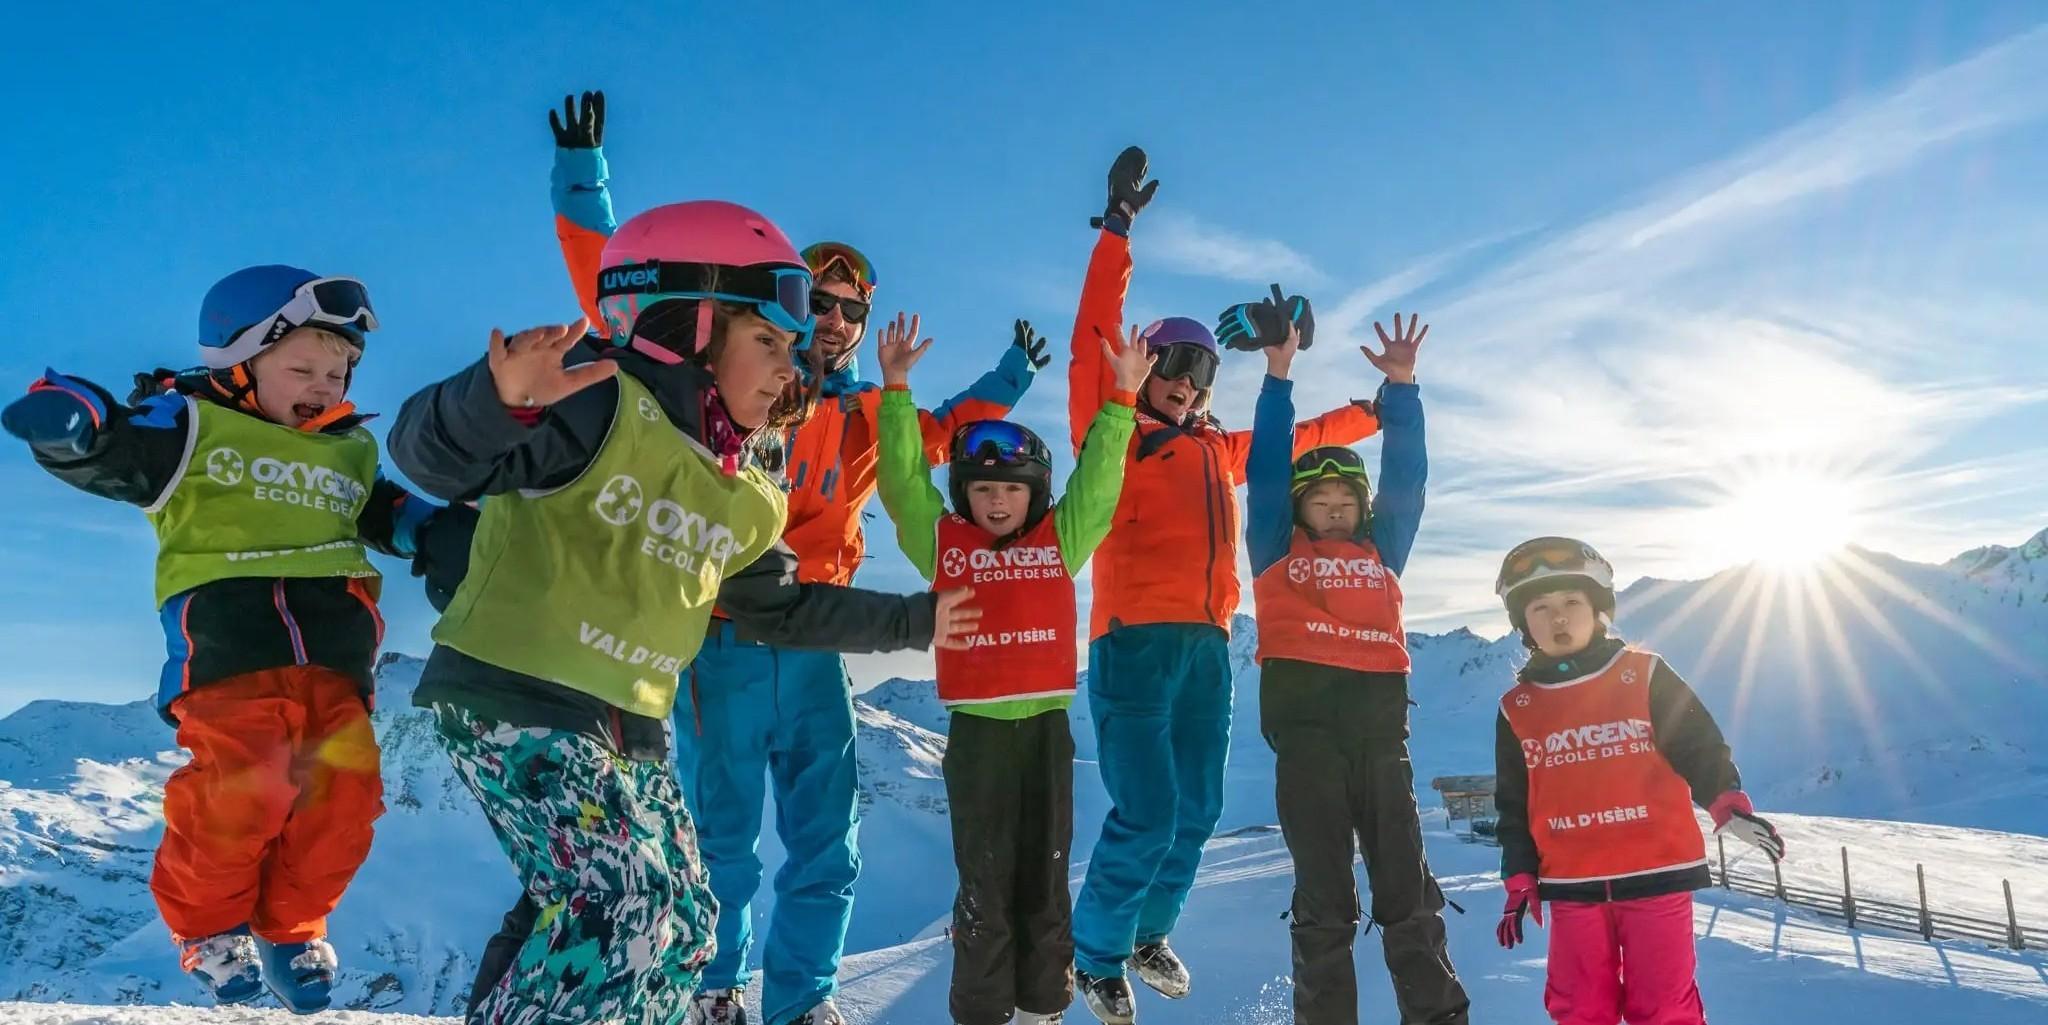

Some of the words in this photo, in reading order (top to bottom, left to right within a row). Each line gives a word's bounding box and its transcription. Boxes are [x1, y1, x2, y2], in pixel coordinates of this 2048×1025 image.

[603, 268, 659, 290] uvex
[254, 486, 326, 510] ECOLE
[329, 500, 349, 516] DE
[647, 499, 745, 561] OXYG
[641, 535, 698, 575] ECOL
[970, 546, 1061, 570] OXYGENE
[973, 569, 1022, 583] ECOLE
[1024, 569, 1039, 579] DE
[1042, 568, 1063, 579] SKI
[965, 632, 996, 648] VAL
[1000, 627, 1057, 645] D'ISÈRE
[1306, 622, 1337, 635] VAL
[579, 621, 627, 662] VAL
[628, 645, 682, 676] D'IS
[1545, 718, 1653, 753] OXYGENE
[1545, 748, 1596, 768] ECOLE
[1602, 746, 1625, 759] DE
[1549, 817, 1575, 830] VAL
[1579, 805, 1648, 827] D'ISÈRE
